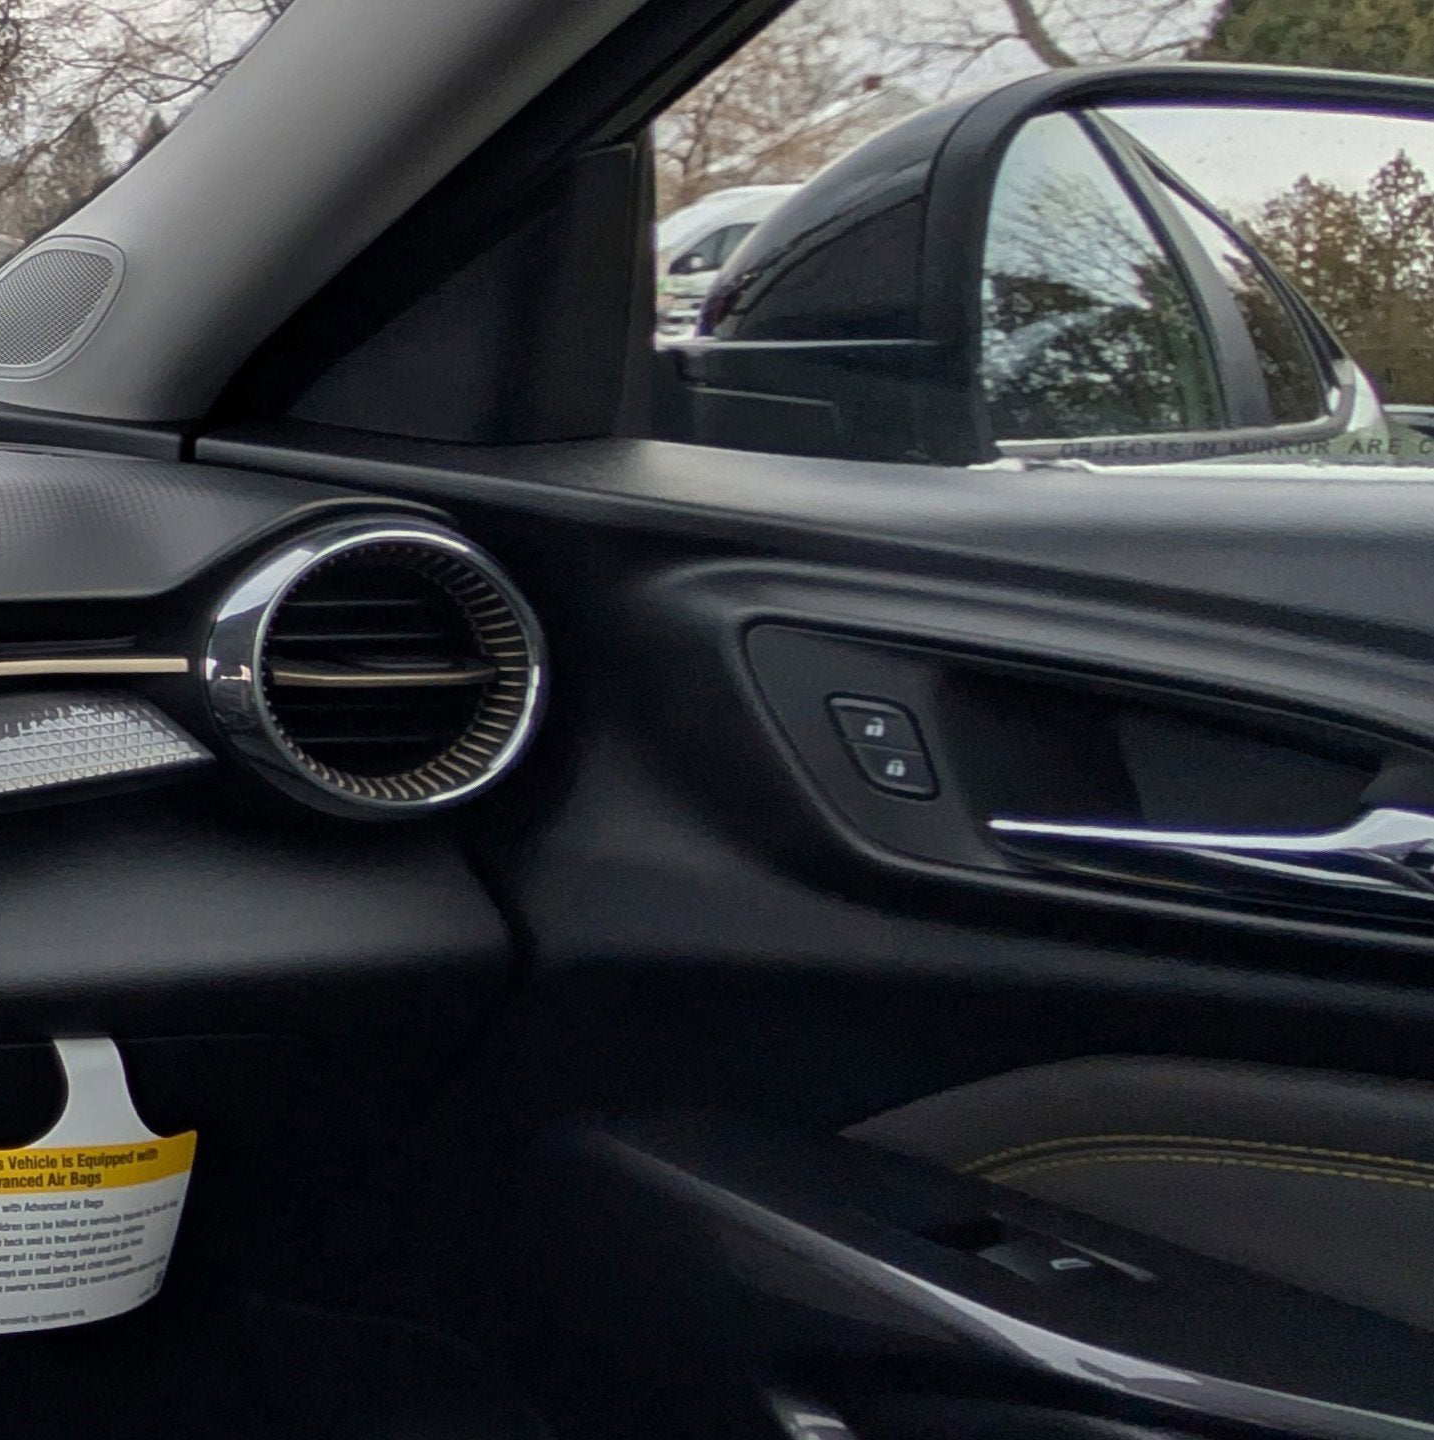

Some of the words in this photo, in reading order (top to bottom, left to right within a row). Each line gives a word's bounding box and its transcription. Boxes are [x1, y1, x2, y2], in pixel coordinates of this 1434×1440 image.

[1347, 438, 1403, 455] ARE
[8, 1155, 58, 1170] Vehicle
[62, 1154, 74, 1168] is
[77, 1150, 134, 1169] Equipped
[137, 1148, 159, 1161] with
[47, 1172, 67, 1186] Air
[70, 1171, 102, 1187] Bags
[2, 1203, 22, 1212] with
[24, 1202, 67, 1212] Advanced
[70, 1200, 80, 1209] Air
[25, 1222, 41, 1230] can
